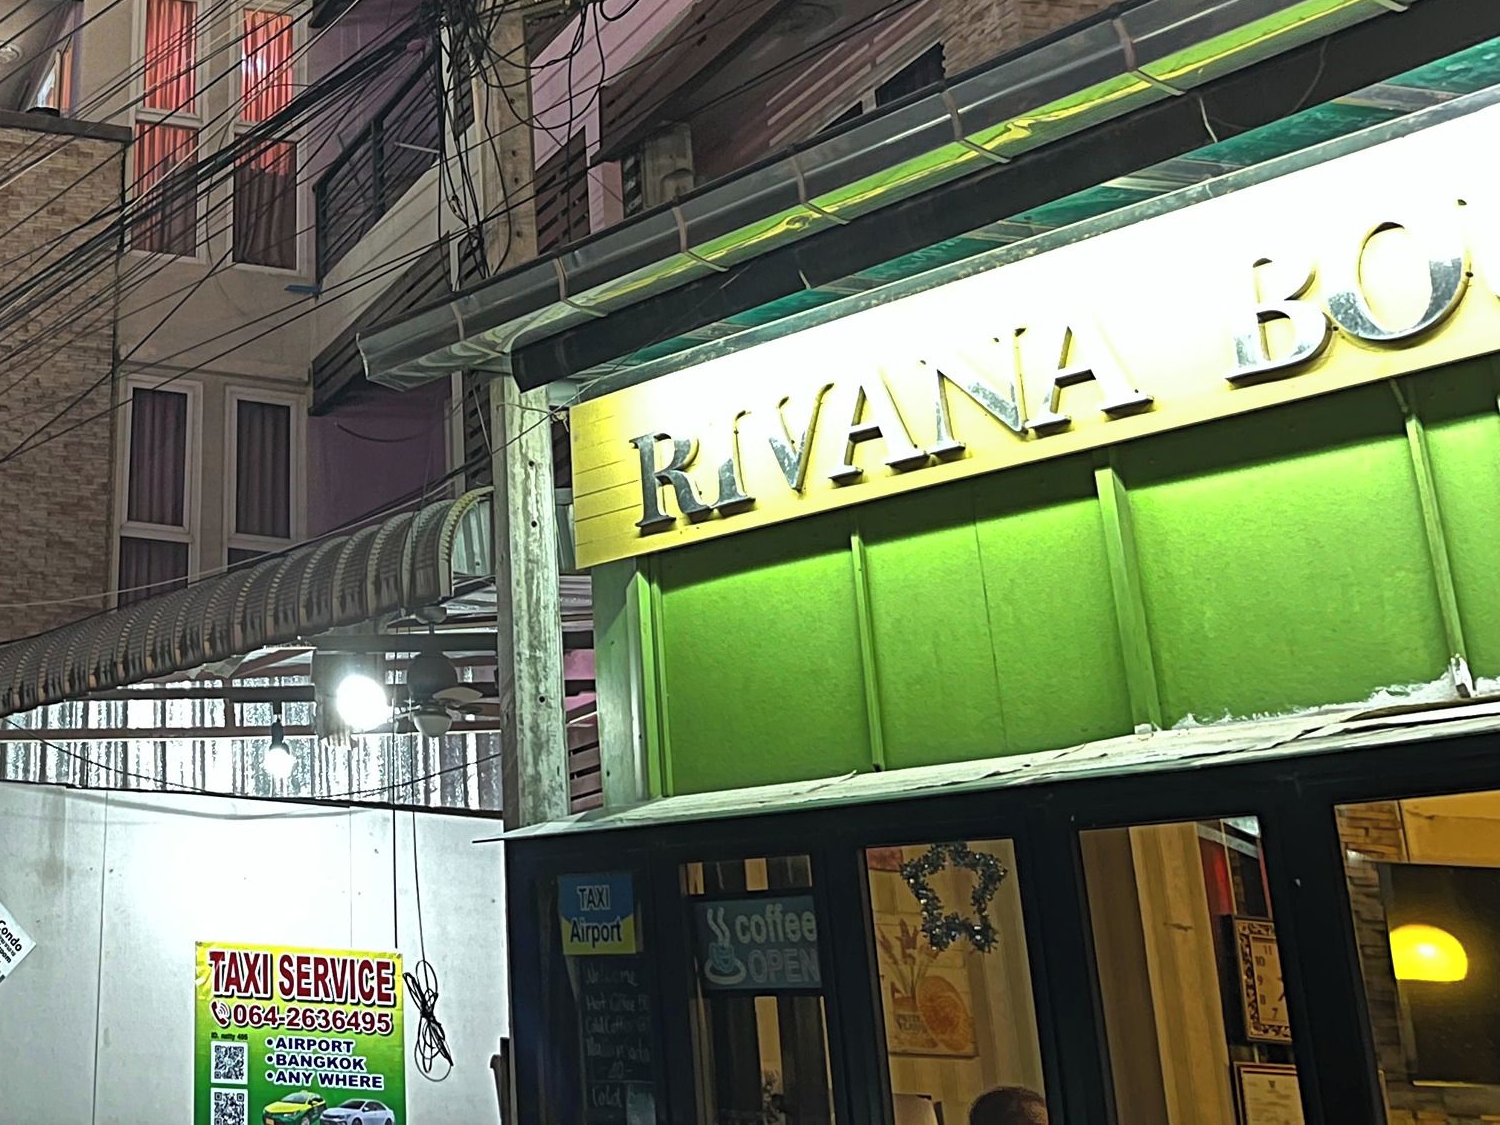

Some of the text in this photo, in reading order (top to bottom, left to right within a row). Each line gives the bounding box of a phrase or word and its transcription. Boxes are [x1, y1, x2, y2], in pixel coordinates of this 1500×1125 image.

[629, 315, 1155, 535] RIVANA
[577, 885, 610, 911] TAXI
[570, 917, 622, 949] Airport
[734, 903, 818, 944] coffee
[208, 950, 393, 1003] TAXI SERVICE
[749, 947, 820, 985] OPEN
[232, 1004, 392, 1033] 064-2636495
[275, 1037, 354, 1053] AIRPORT
[275, 1054, 365, 1071] BANGKOK
[275, 1071, 383, 1088] ANY WHERE
